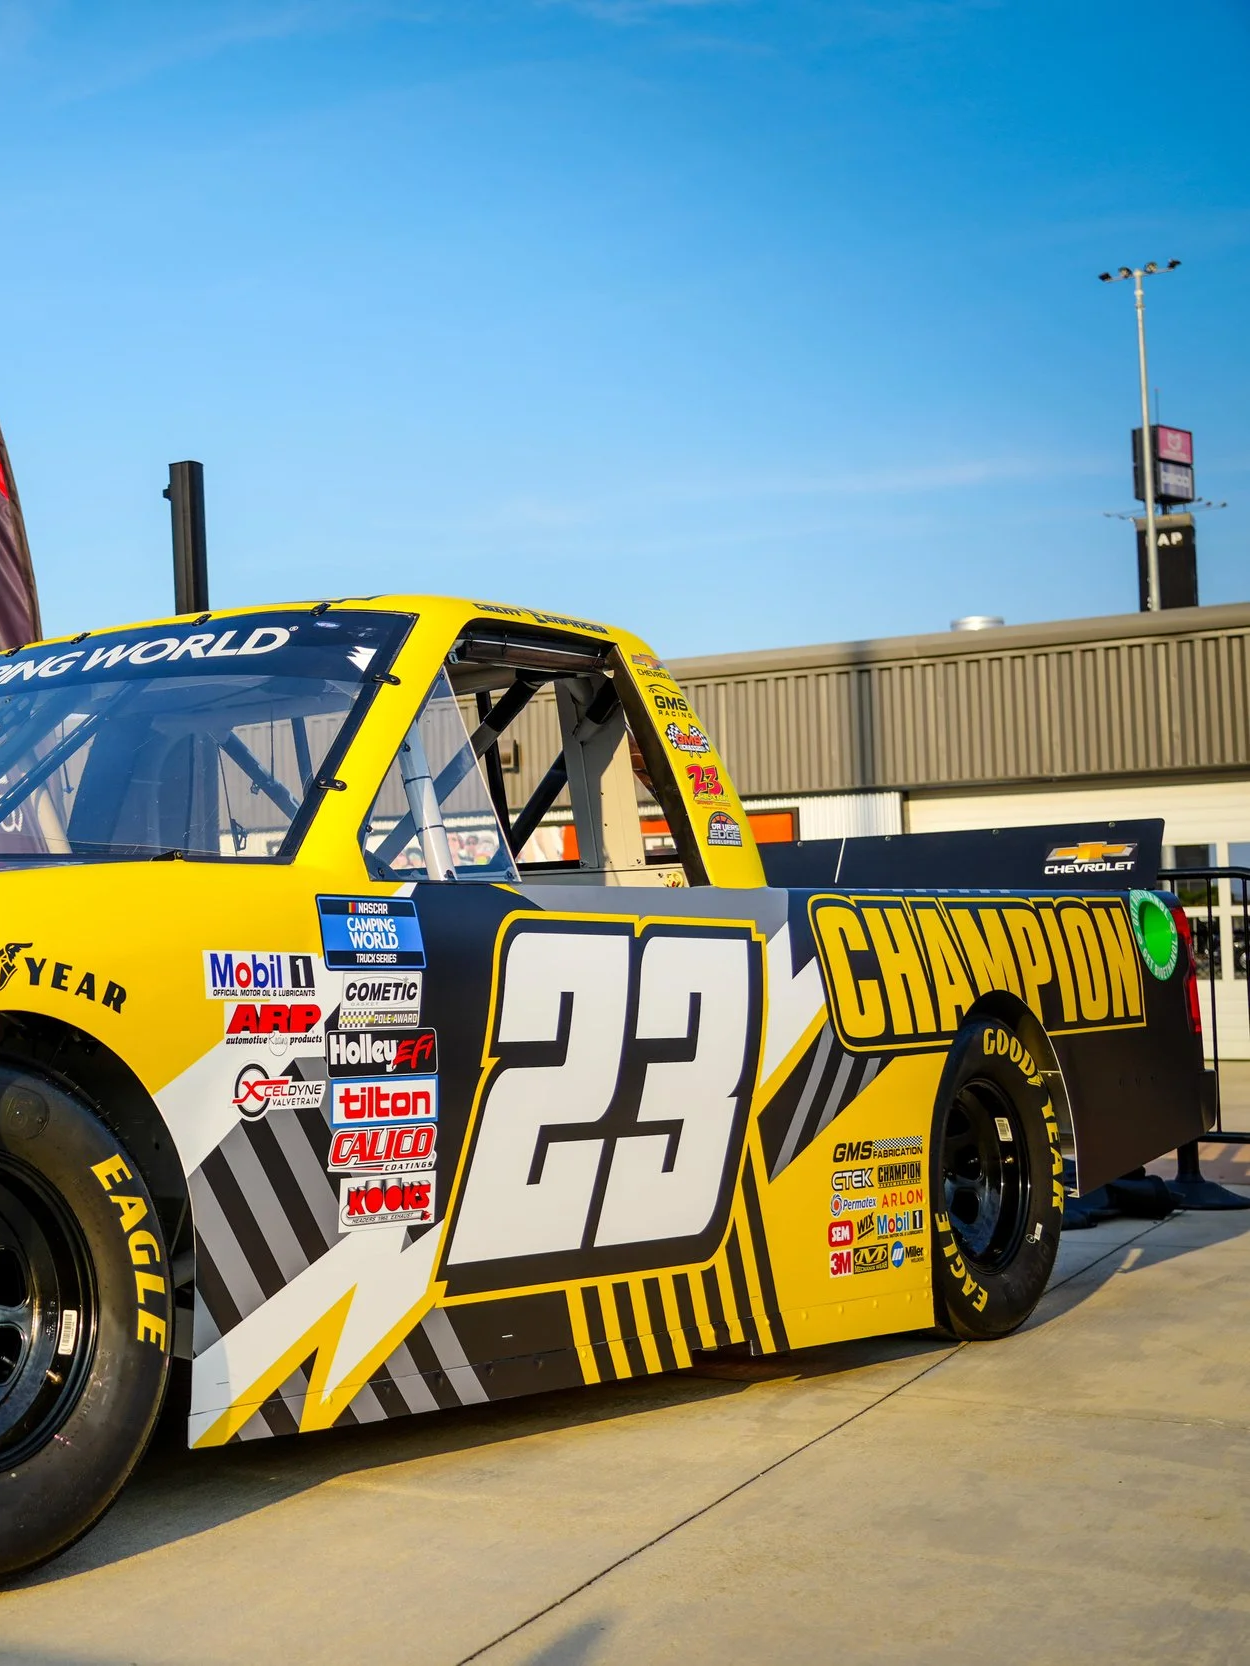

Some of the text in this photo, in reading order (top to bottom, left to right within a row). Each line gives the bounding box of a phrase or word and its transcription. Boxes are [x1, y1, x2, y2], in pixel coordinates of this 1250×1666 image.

[83, 626, 292, 672] WORLD
[654, 695, 689, 711] GMS
[658, 709, 693, 719] RACING
[675, 734, 703, 746] GMS
[686, 764, 724, 796] 23
[710, 830, 740, 840] EDGE
[1044, 861, 1136, 875] CHEVROLET
[358, 902, 388, 915] NASCAR
[347, 918, 396, 932] CAMPING
[349, 932, 399, 949] WORLD
[356, 953, 397, 964] TRUCK SERIES
[210, 953, 311, 989] Mobil 1
[819, 906, 1142, 1039] CHAMPION
[346, 982, 418, 1002] COMETIC
[226, 1004, 322, 1034] ARP
[374, 1013, 418, 1024] POLE AWARD
[226, 1035, 267, 1045] automotive
[290, 1035, 322, 1045] products
[330, 1033, 397, 1073] Holley
[232, 1080, 323, 1104] XCELDYNE
[272, 1097, 320, 1107] VALVETRAIN
[447, 932, 748, 1265] 23
[339, 1087, 431, 1119] tilton
[331, 1127, 435, 1165] CALICO
[833, 1141, 923, 1163] GMS FABRICATION
[385, 1162, 433, 1171] COATINGS
[878, 1162, 921, 1183] CHAMPION
[832, 1168, 874, 1191] CTEK
[347, 1181, 431, 1215] KOOKS
[843, 1198, 877, 1211] Permatex
[881, 1189, 923, 1208] ARLON
[352, 1216, 376, 1224] HEADERS
[857, 1212, 874, 1235] WIX
[877, 1210, 921, 1235] Mobil 1
[831, 1225, 850, 1242] SEM
[91, 1153, 167, 1353] EAGLE
[905, 1246, 924, 1258] Miller
[935, 1211, 988, 1313] EAGLE
[830, 1251, 851, 1276] 3M
